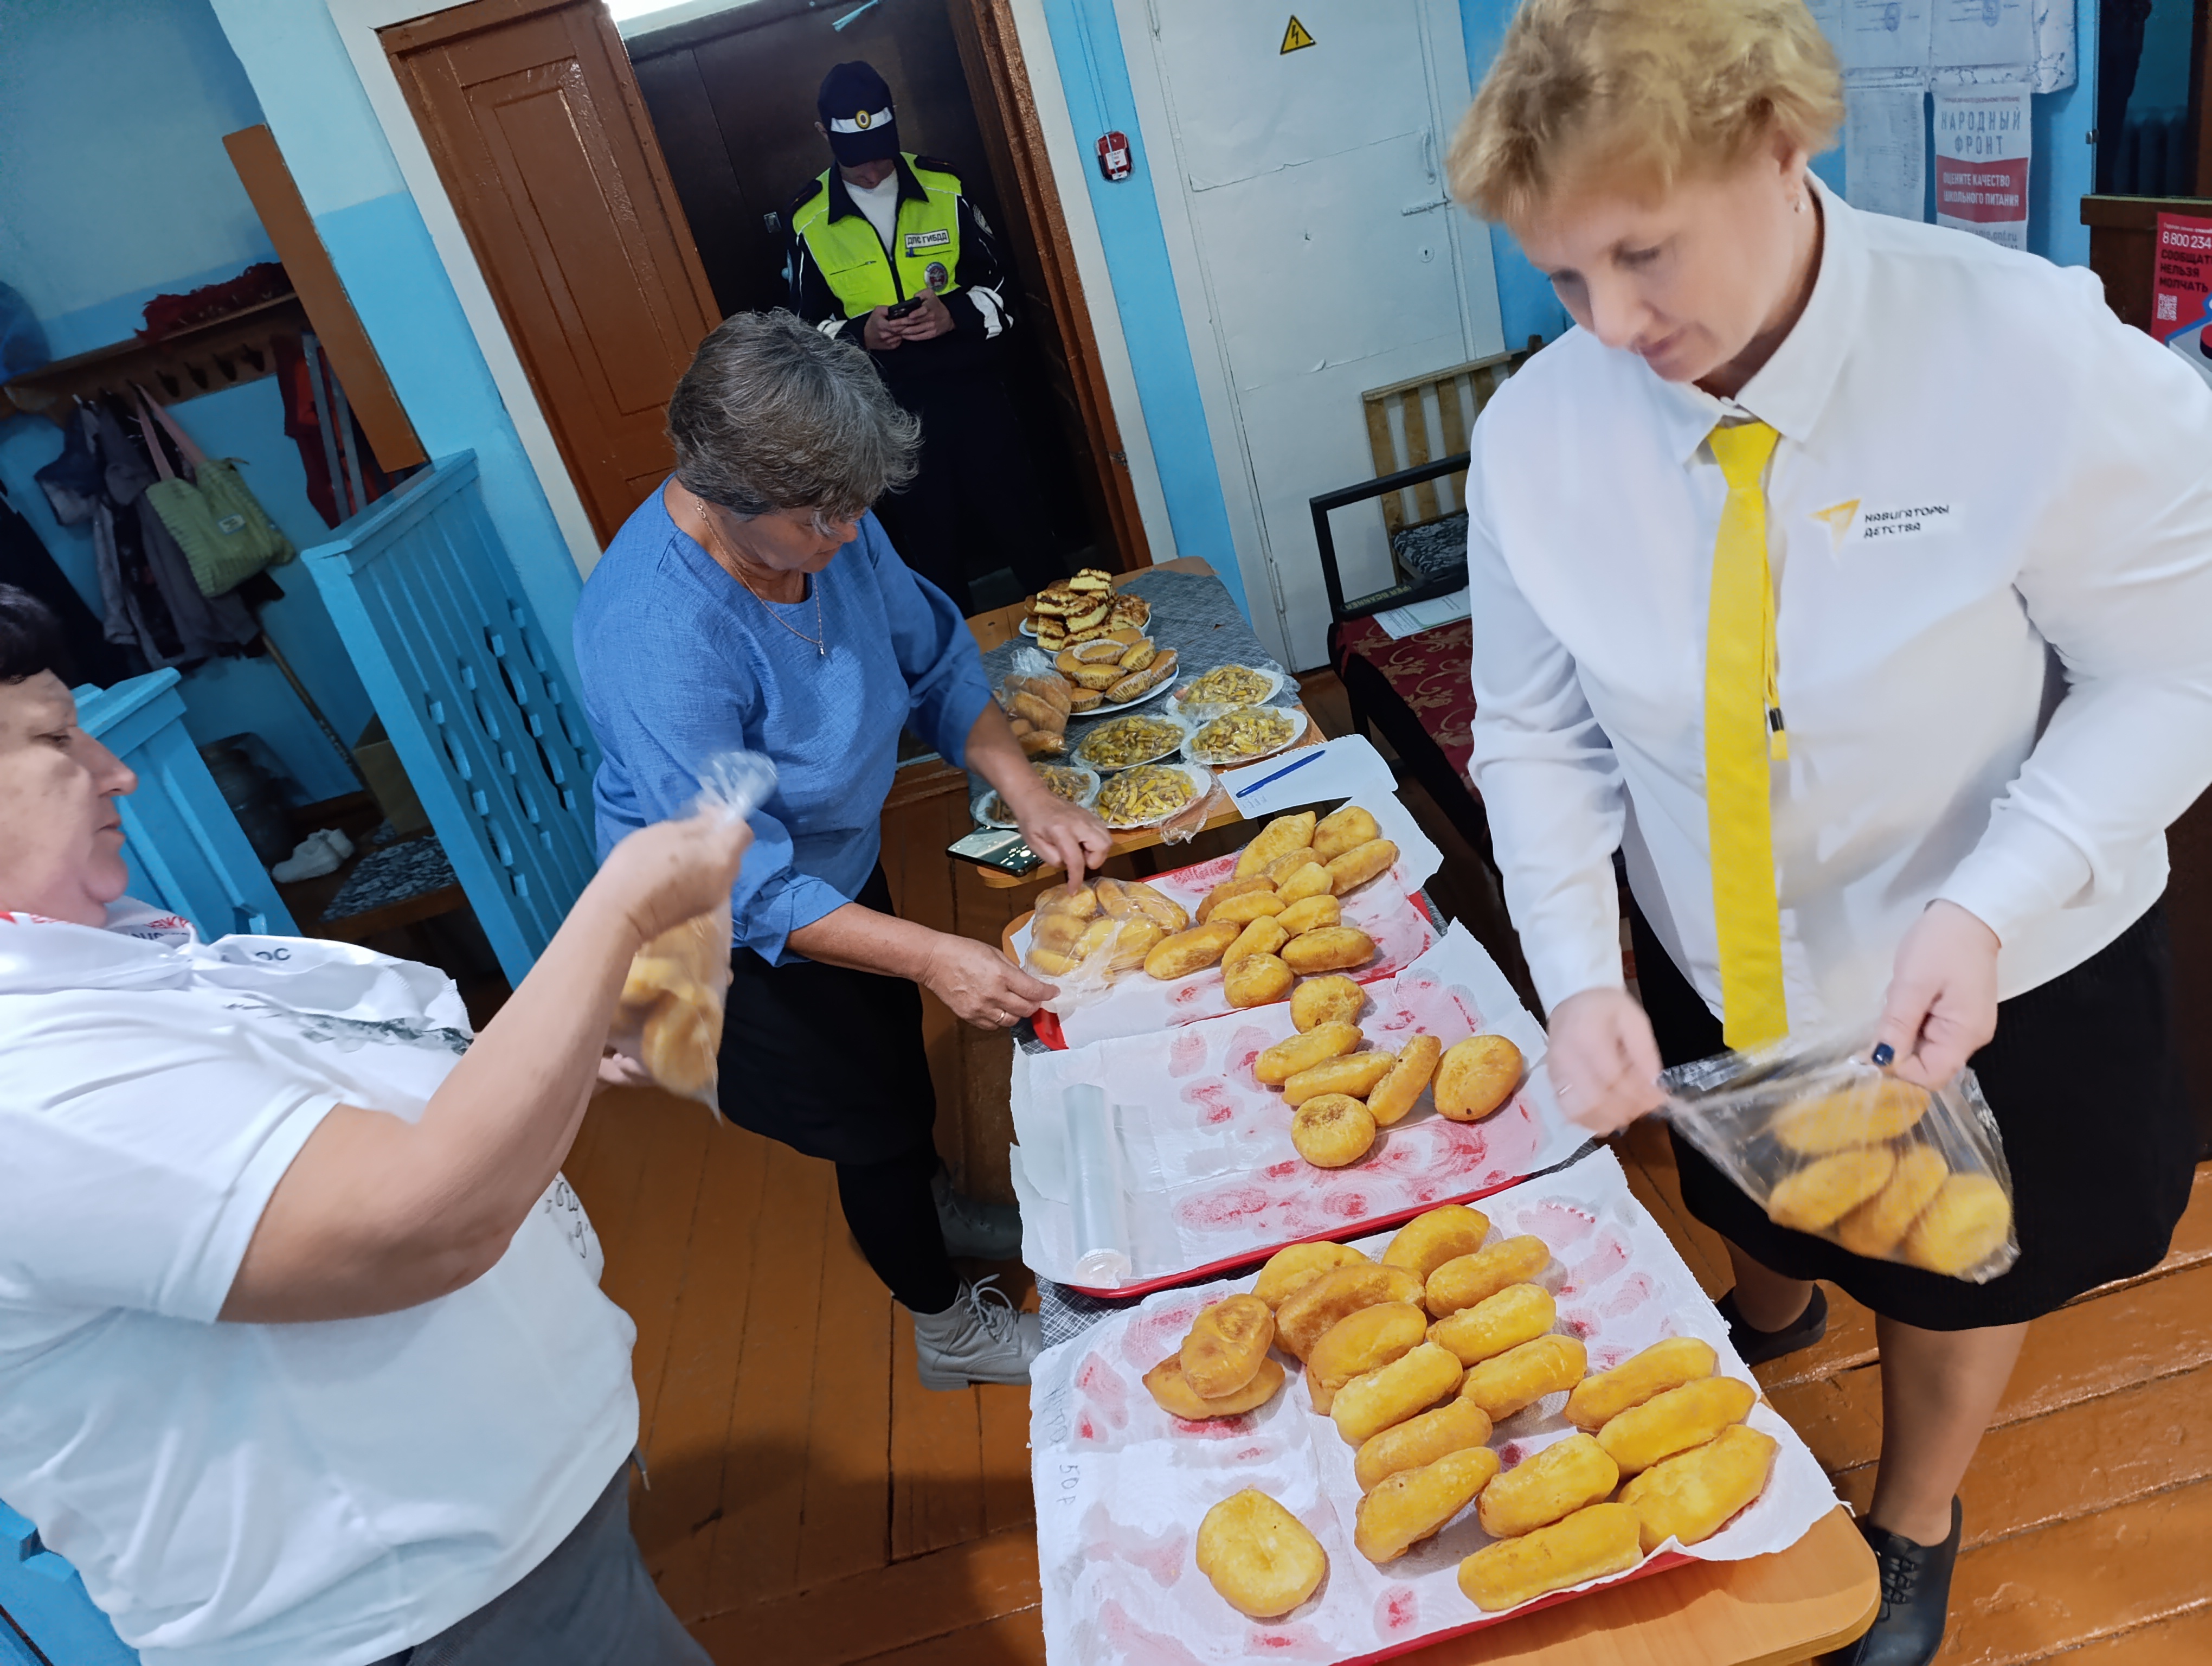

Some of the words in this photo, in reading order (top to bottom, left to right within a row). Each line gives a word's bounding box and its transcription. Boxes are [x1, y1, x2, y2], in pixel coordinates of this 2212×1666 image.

[1941, 107, 2021, 133] НАРОДНЫЙ
[1954, 134, 2003, 155] ФРОНТ
[1943, 172, 1972, 185] ОЦЕНИТЕ
[1972, 173, 2011, 188] КАЧЕСТВО
[1943, 190, 1984, 205] ШКОЛЬНОГО
[1985, 193, 2020, 207] ПИТАНИЯ
[907, 236, 922, 246] ДПС
[922, 232, 948, 244] ГИБДД
[2162, 231, 2169, 244] 8
[2170, 233, 2190, 247] 800
[2190, 235, 2212, 249] 234
[2160, 262, 2200, 278] НЕЛЬЗЯ
[2159, 277, 2209, 292] МОЛЧАТЬ
[1865, 504, 1950, 522] НАВИГАТОРЫ
[1864, 522, 1920, 538] ДЕТСТВА
